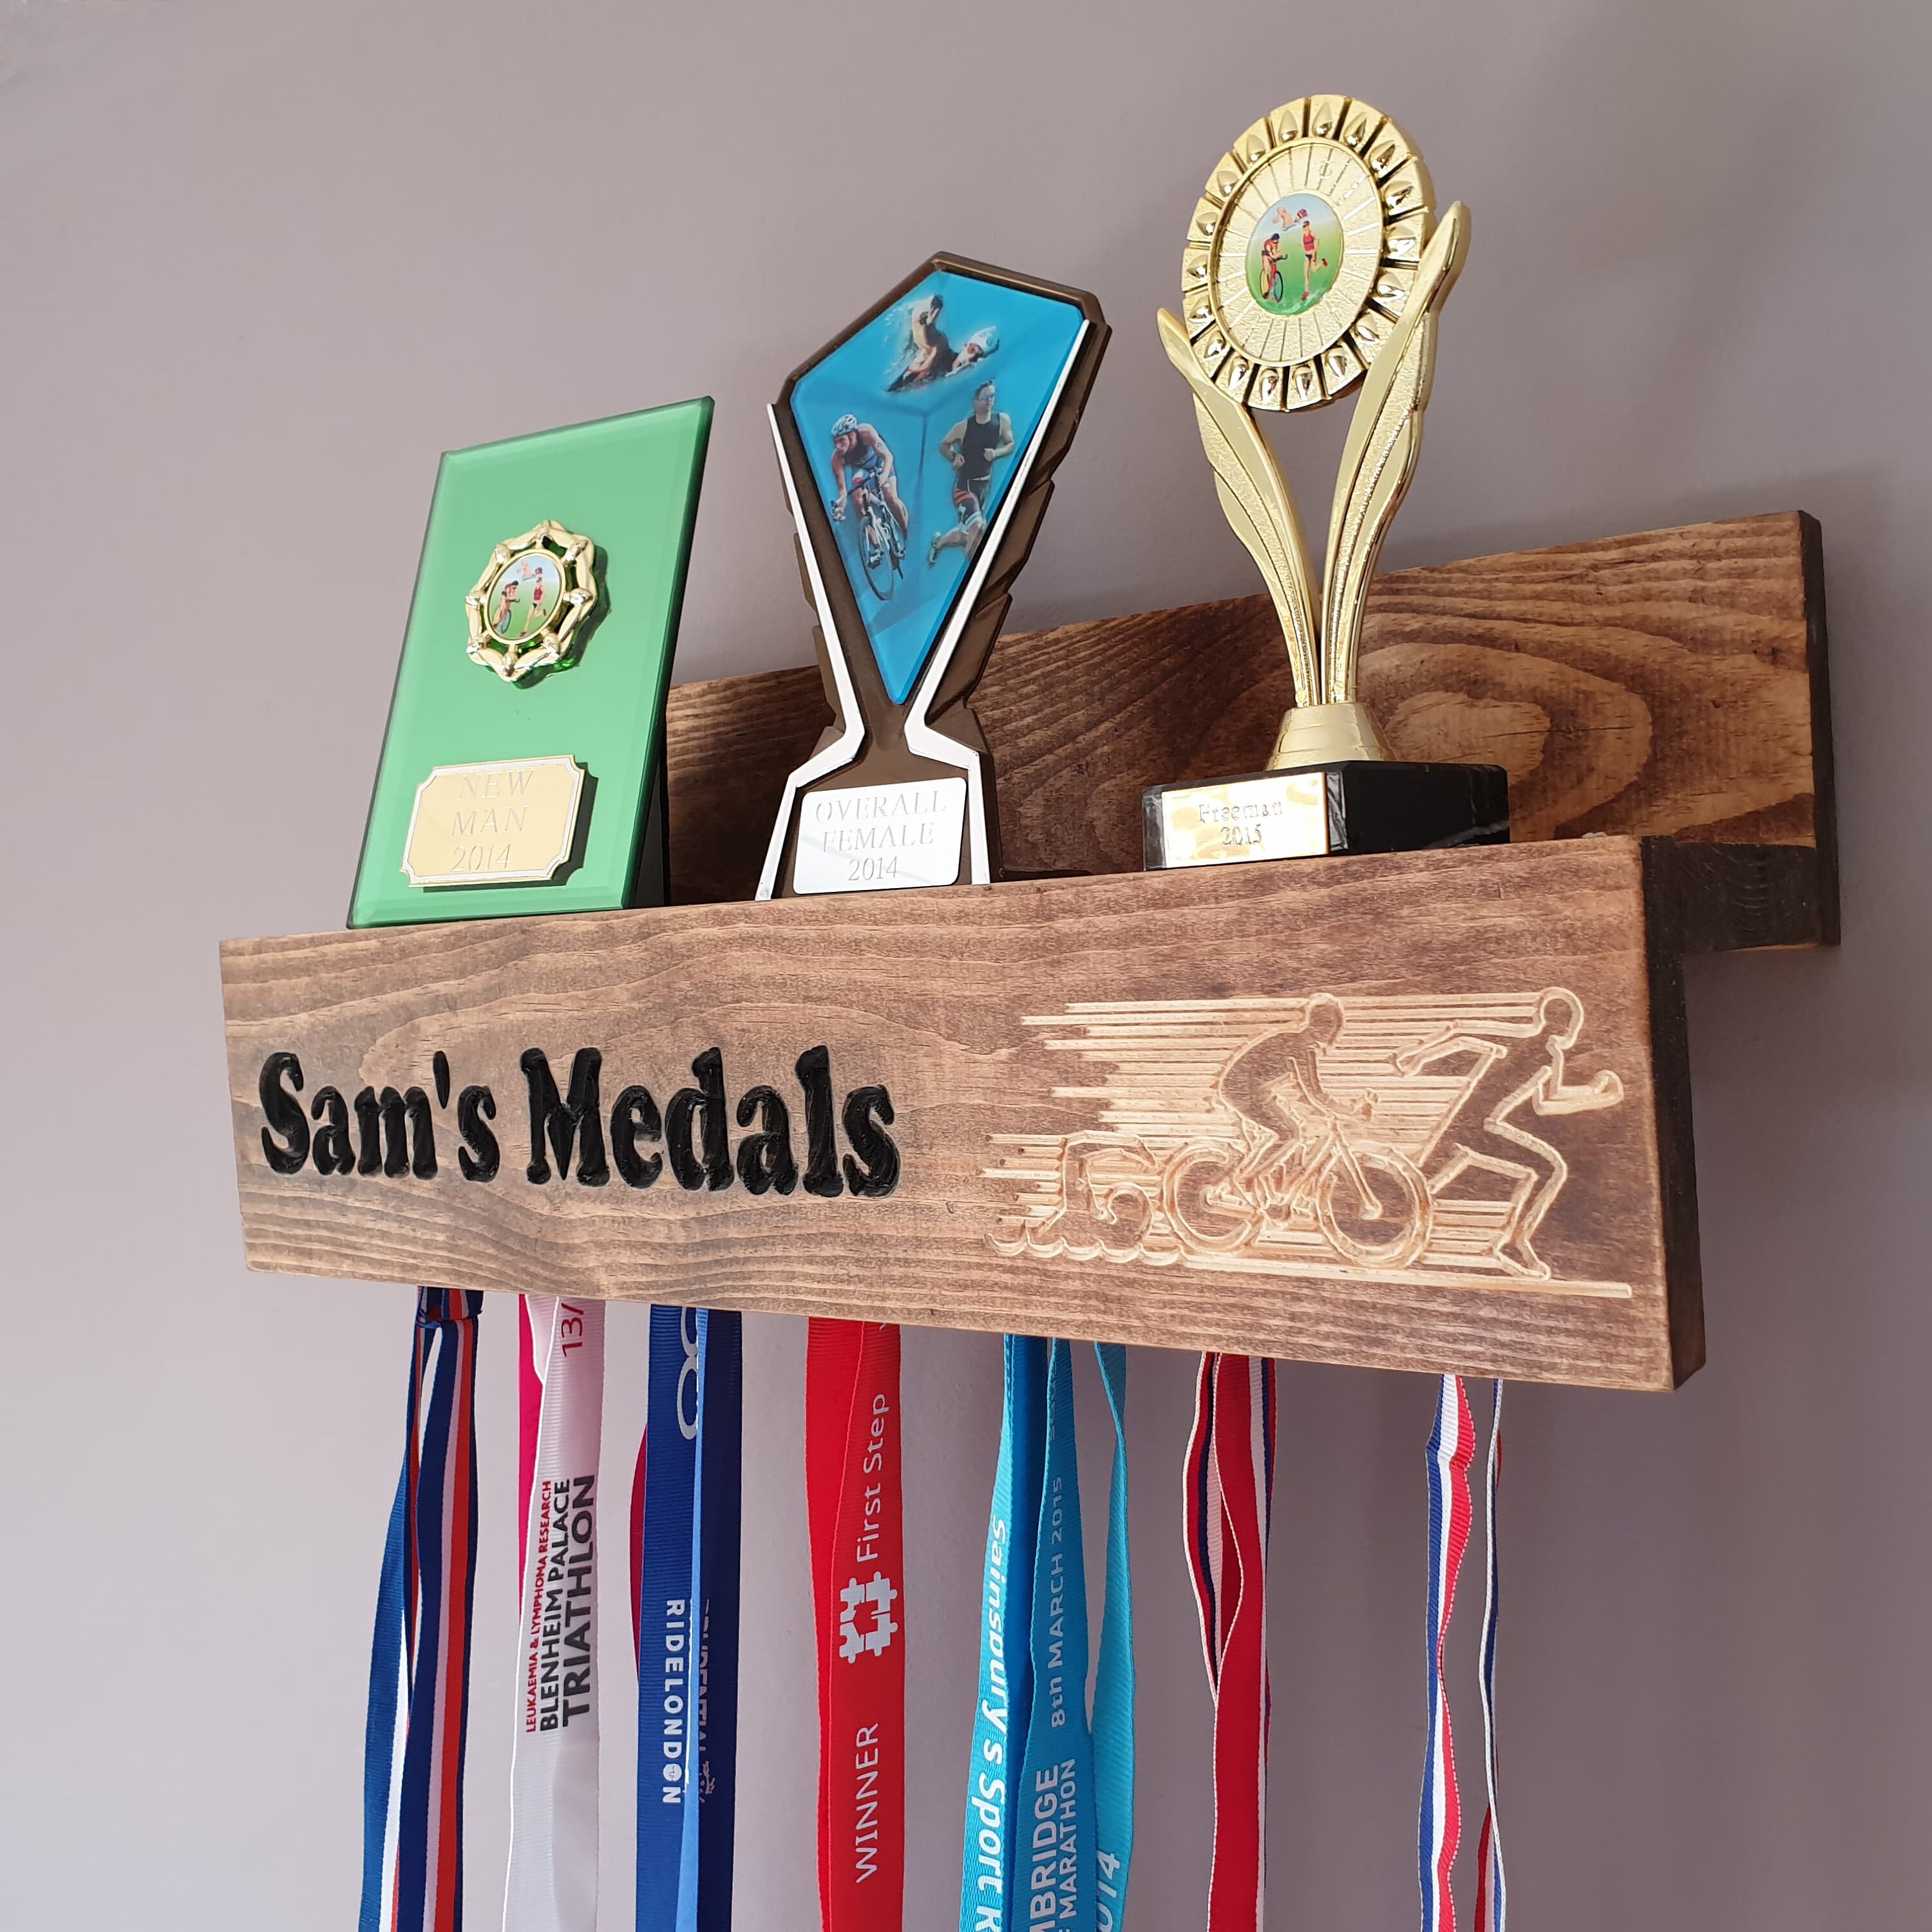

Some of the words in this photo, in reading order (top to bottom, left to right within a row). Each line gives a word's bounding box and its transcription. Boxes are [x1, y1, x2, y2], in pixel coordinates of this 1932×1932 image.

[451, 805, 531, 837] MAN
[457, 767, 536, 801] NEW
[815, 790, 947, 823] OVERALL
[1198, 801, 1283, 824] Freeman
[451, 843, 511, 872] 2014
[822, 822, 934, 853] FEMALE
[848, 856, 898, 882] 2014
[1220, 824, 1262, 846] 2015
[258, 1050, 500, 1183] Sam's
[519, 1045, 902, 1197] Medals
[863, 1393, 890, 1475] Step
[538, 1481, 552, 1553] RESEARCH
[547, 1477, 570, 1582] PALACE
[857, 1482, 882, 1562] First
[1050, 1476, 1063, 1544] 2015
[531, 1555, 548, 1635] LYMPHOMA
[562, 1474, 595, 1728] TRIATHLON
[1047, 1553, 1065, 1669] MARCH
[529, 1637, 539, 1649] &
[540, 1588, 564, 1732] BLENHEIM
[526, 1652, 538, 1733] LEUKAEMIA
[1051, 1676, 1066, 1728] 8th
[855, 1722, 878, 1884] WINNER
[971, 1773, 1006, 1895] Sport
[1058, 1758, 1077, 1919] MARATHON
